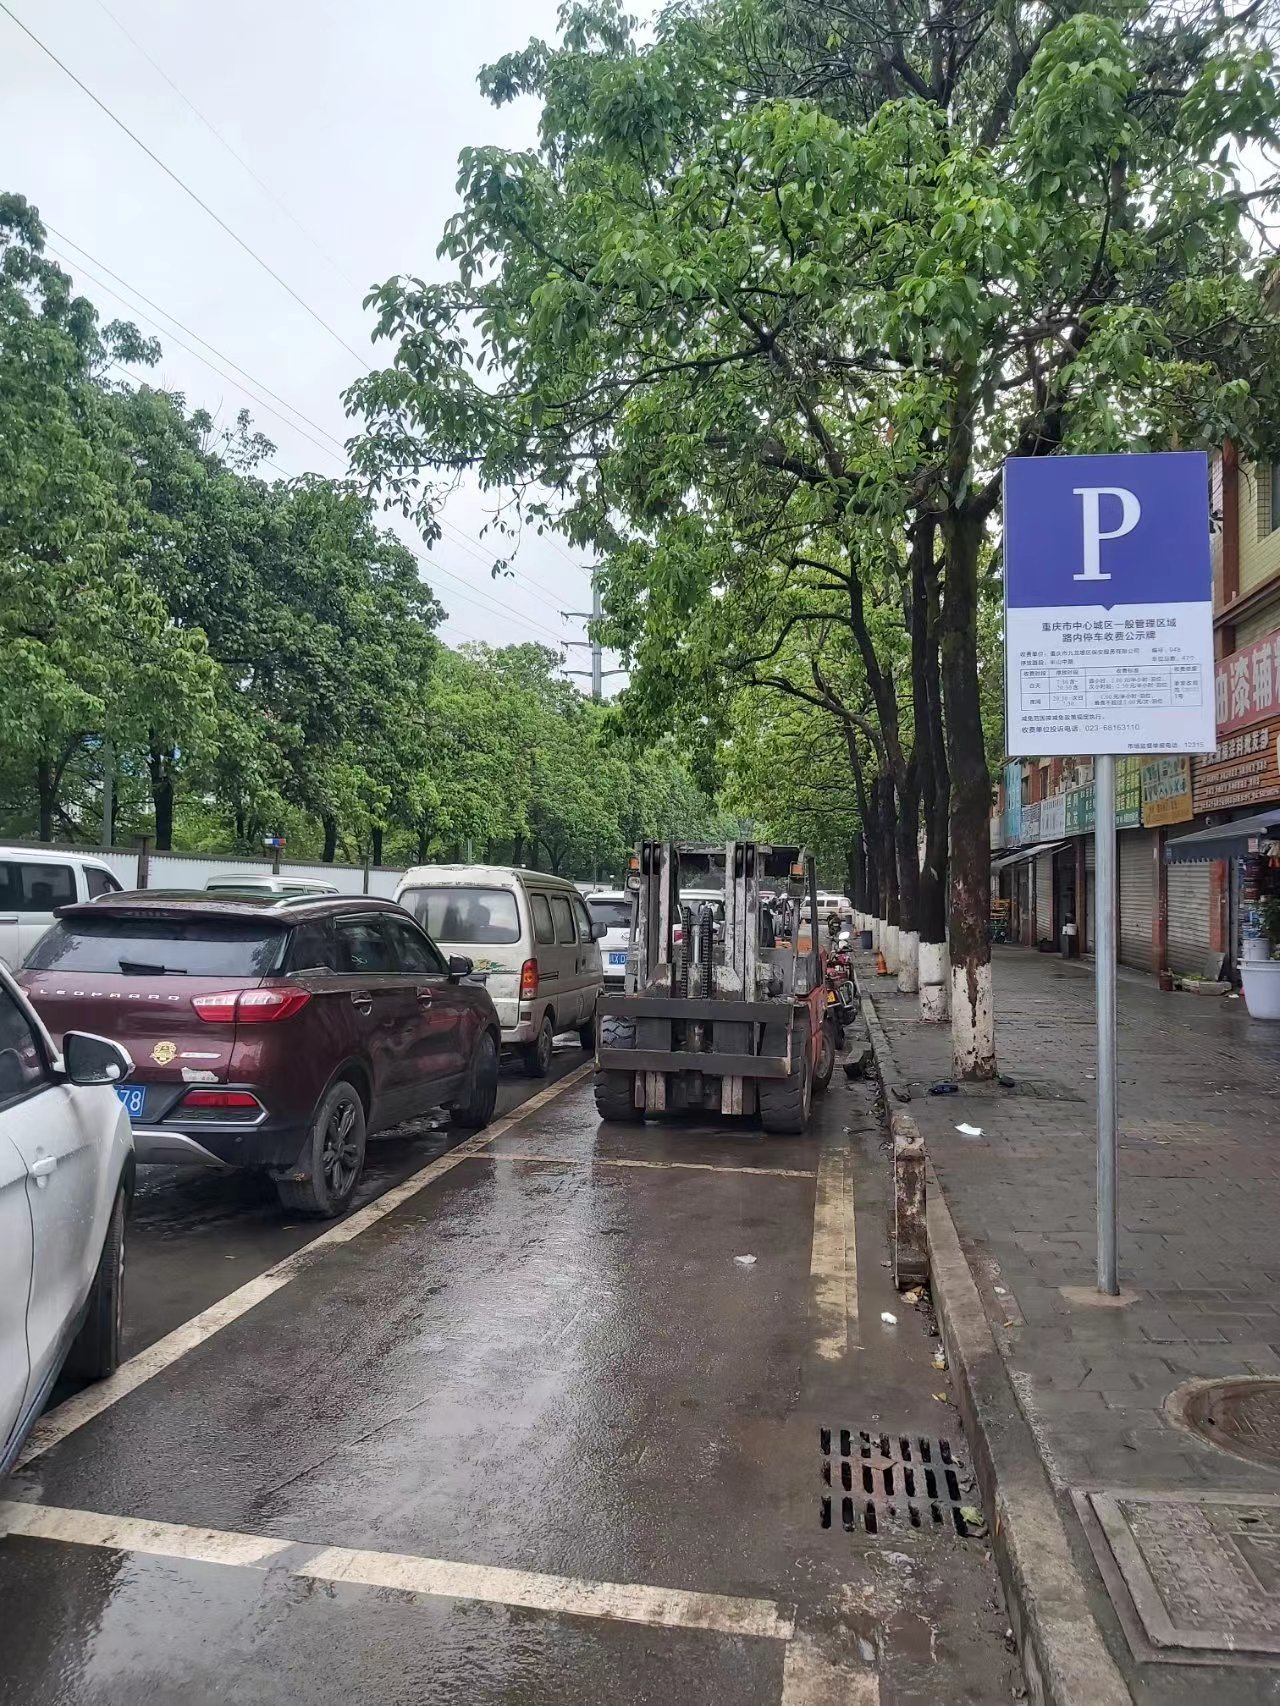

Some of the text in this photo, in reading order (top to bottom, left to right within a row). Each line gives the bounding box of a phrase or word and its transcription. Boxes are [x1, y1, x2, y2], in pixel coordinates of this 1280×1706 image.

[1073, 487, 1142, 581] P
[1041, 618, 1177, 633] 重庆市中心城区一般管理区域
[1062, 631, 1157, 643] 路内停车收费公示牌
[40, 988, 180, 1001] LEOPAARD
[116, 1089, 142, 1112] 78
